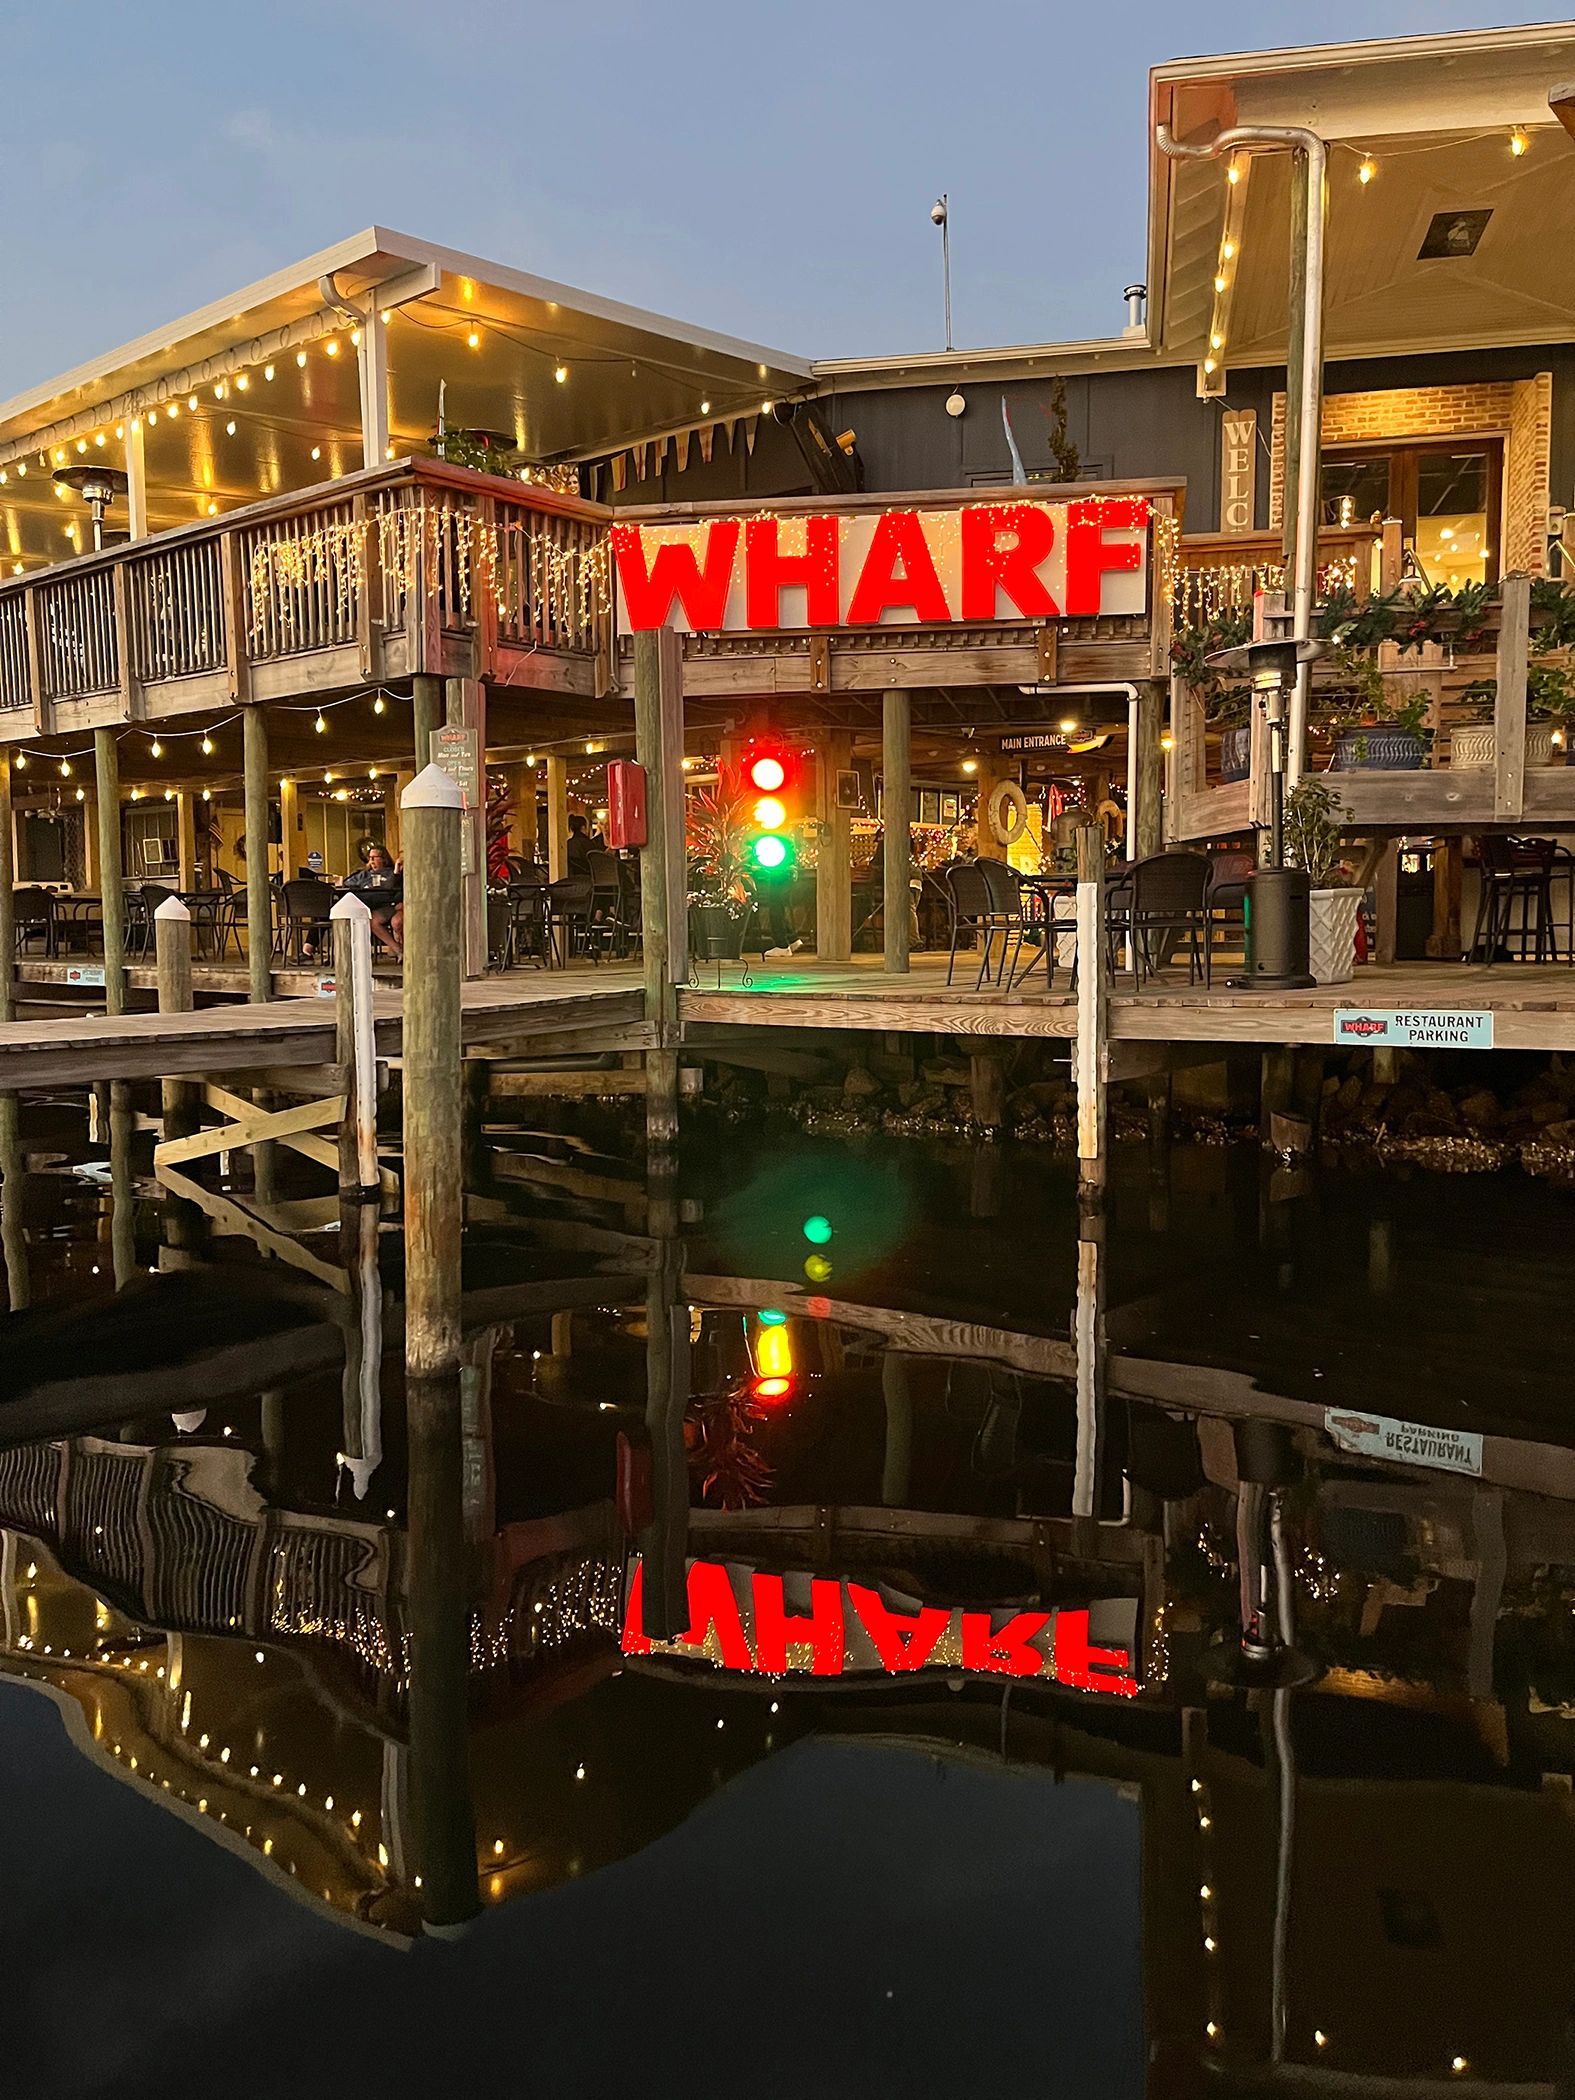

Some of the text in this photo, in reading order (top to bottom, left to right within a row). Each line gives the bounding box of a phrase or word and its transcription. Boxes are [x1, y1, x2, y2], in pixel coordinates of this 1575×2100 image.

[1224, 420, 1255, 532] WELC
[610, 498, 1150, 631] WHARF
[1001, 737, 1021, 750] MAIN
[1023, 733, 1067, 749] ENTRANCE
[1344, 1021, 1384, 1033] WHARF
[1395, 1015, 1484, 1028] RESTAURANT
[1409, 1029, 1469, 1042] PARKING
